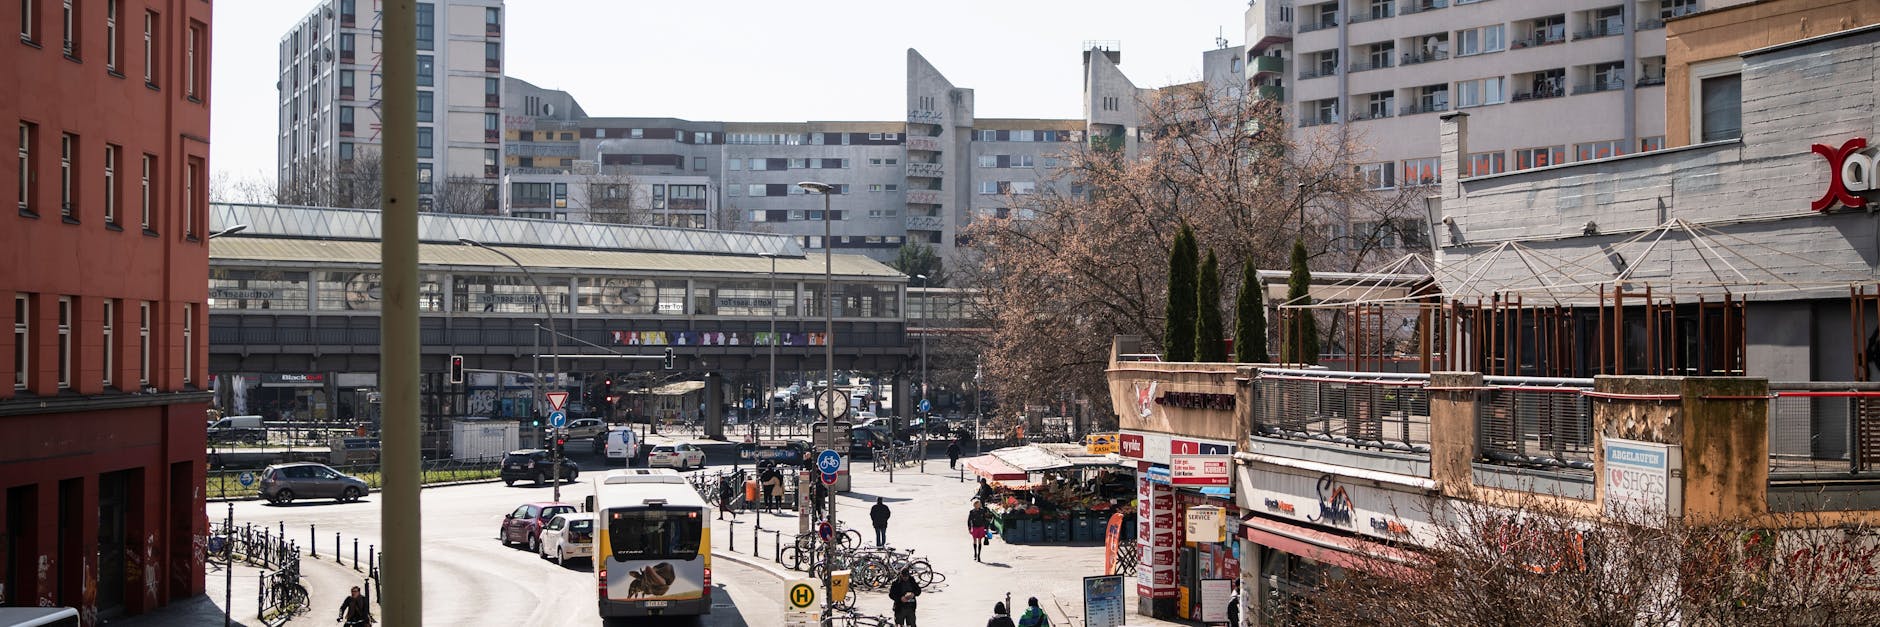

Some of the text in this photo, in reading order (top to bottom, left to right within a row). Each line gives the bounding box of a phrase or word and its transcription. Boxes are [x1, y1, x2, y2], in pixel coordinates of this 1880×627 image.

[1612, 449, 1660, 465] ABGELAUFEN
[1622, 470, 1665, 496] SHOES
[1188, 513, 1211, 521] SERVICE
[796, 589, 808, 603] H
